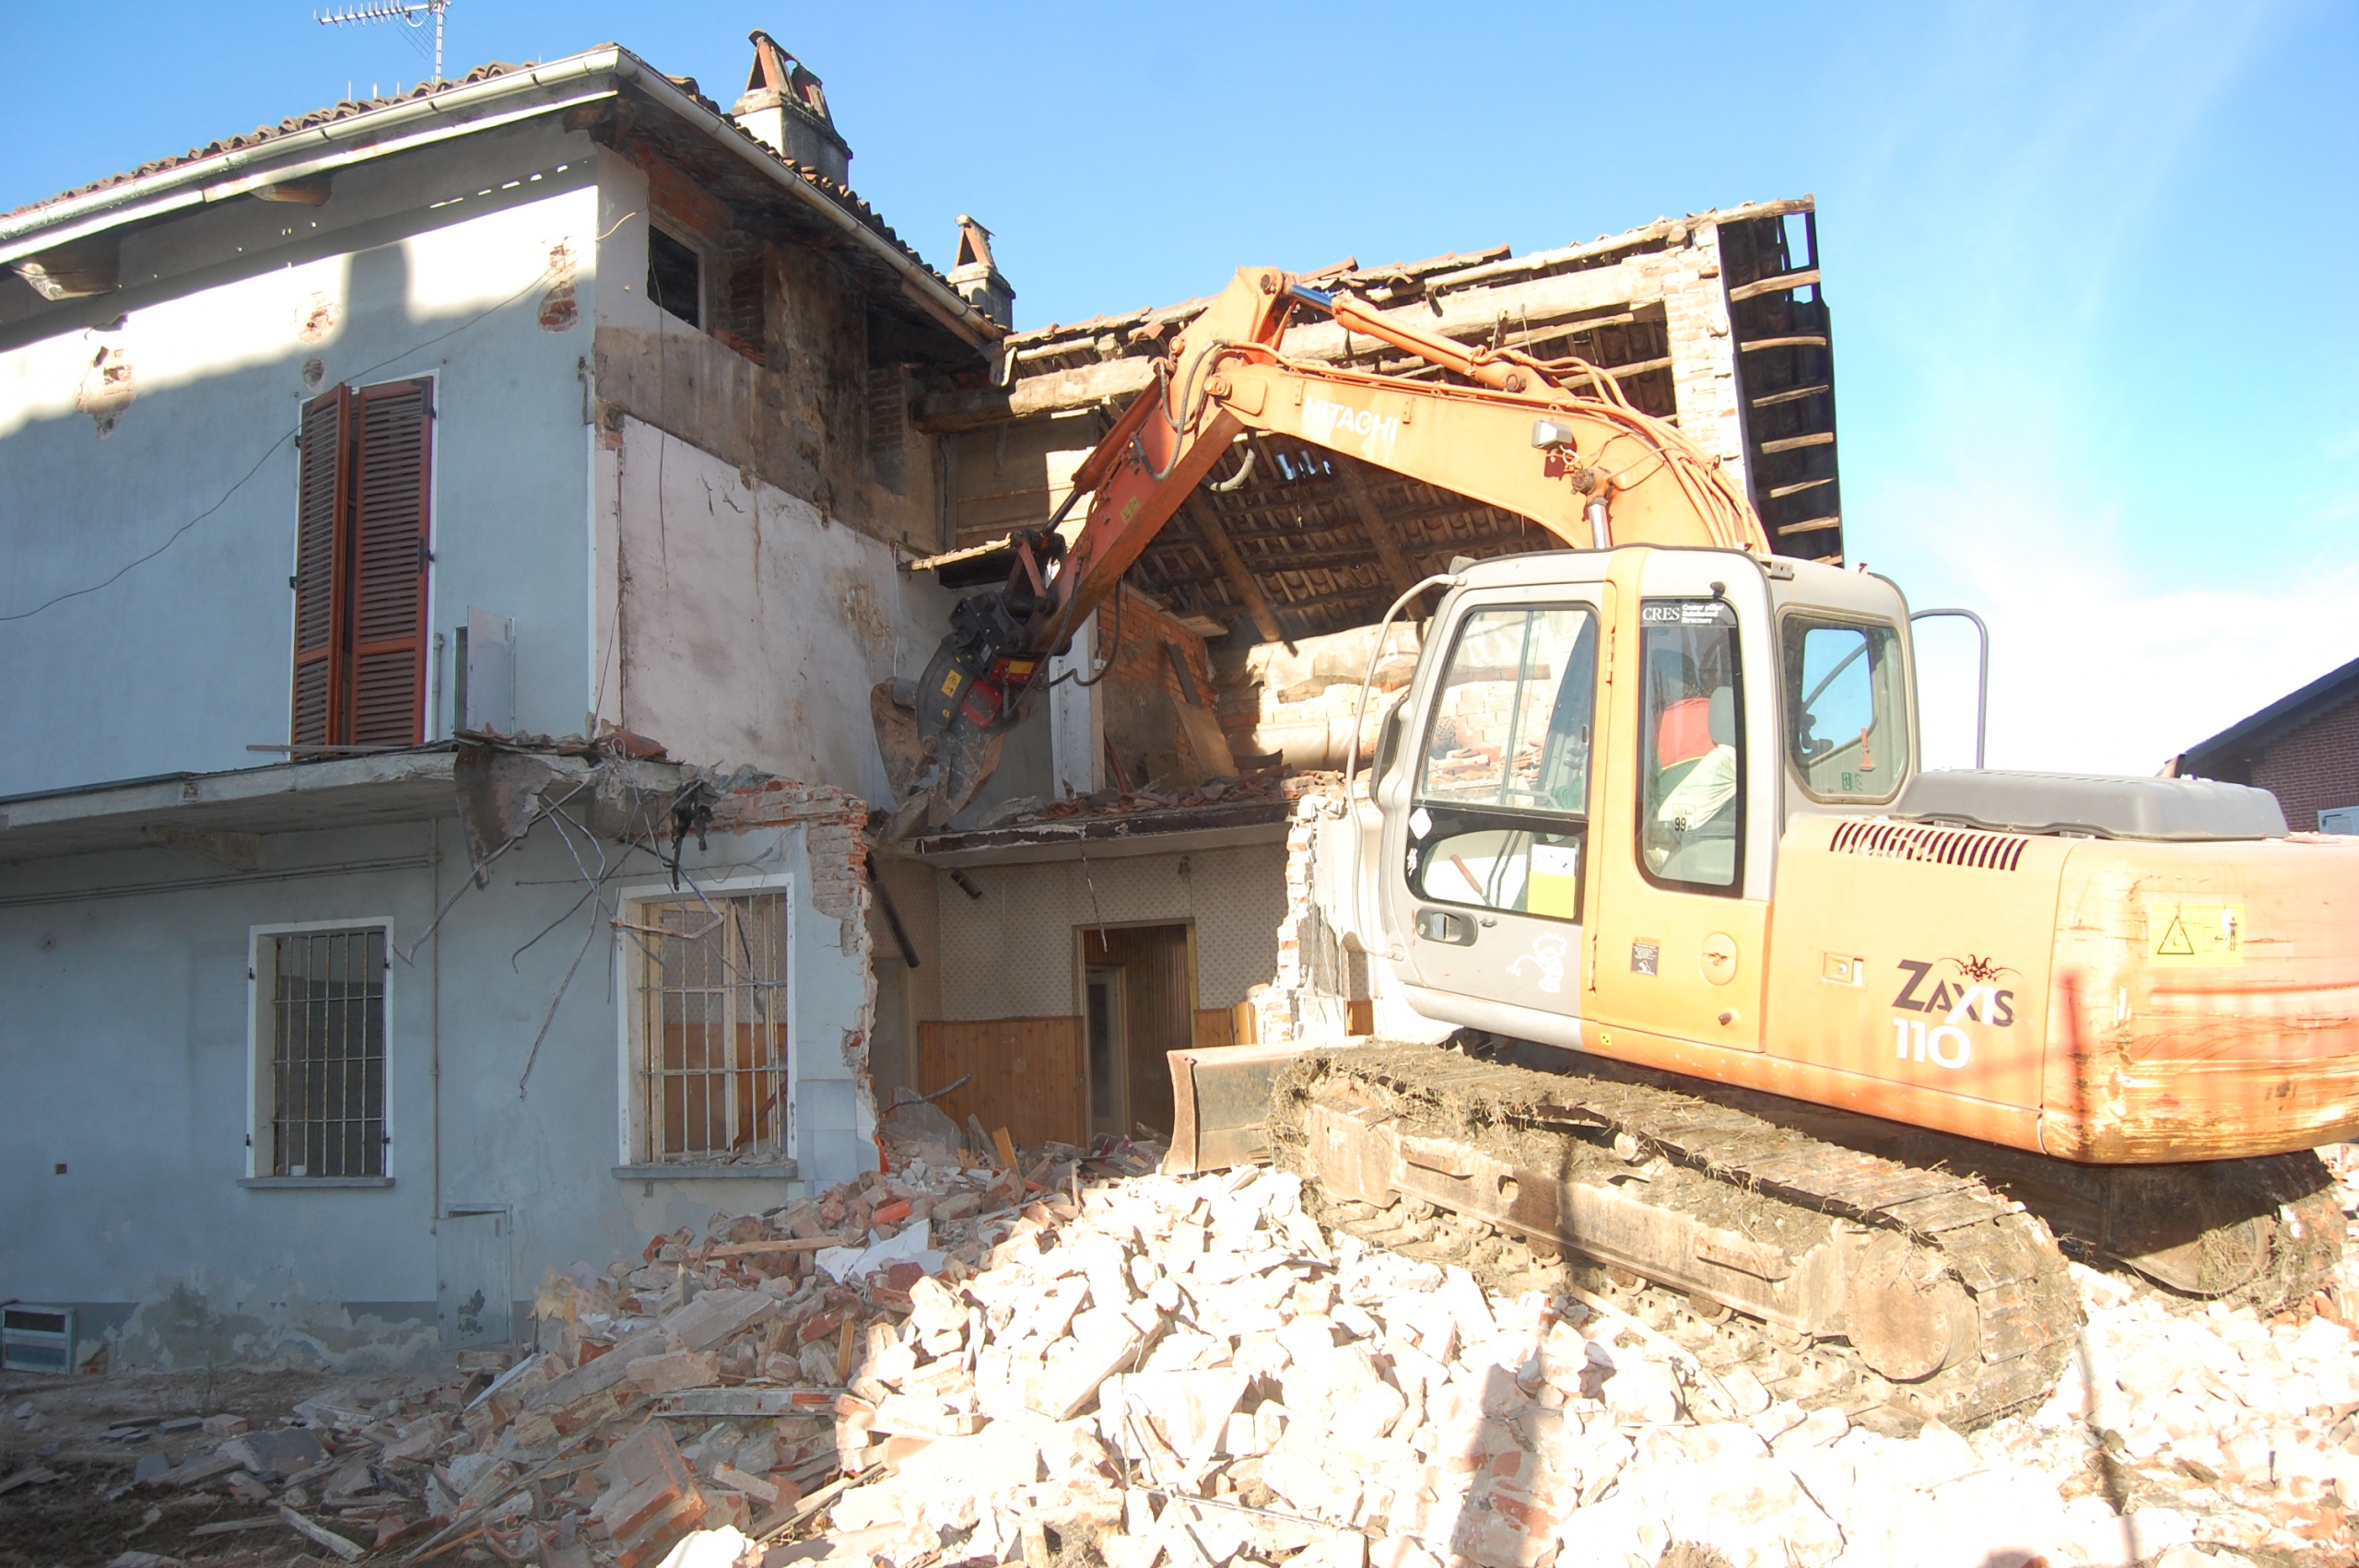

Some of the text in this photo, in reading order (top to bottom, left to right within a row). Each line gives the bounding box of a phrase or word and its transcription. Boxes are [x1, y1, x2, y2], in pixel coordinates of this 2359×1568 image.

[1302, 396, 1399, 442] HITACHI
[1642, 607, 1680, 622] CRES
[1674, 816, 1686, 832] 99
[1892, 959, 2014, 1027] ZAXIS
[1893, 1017, 1971, 1070] 110
